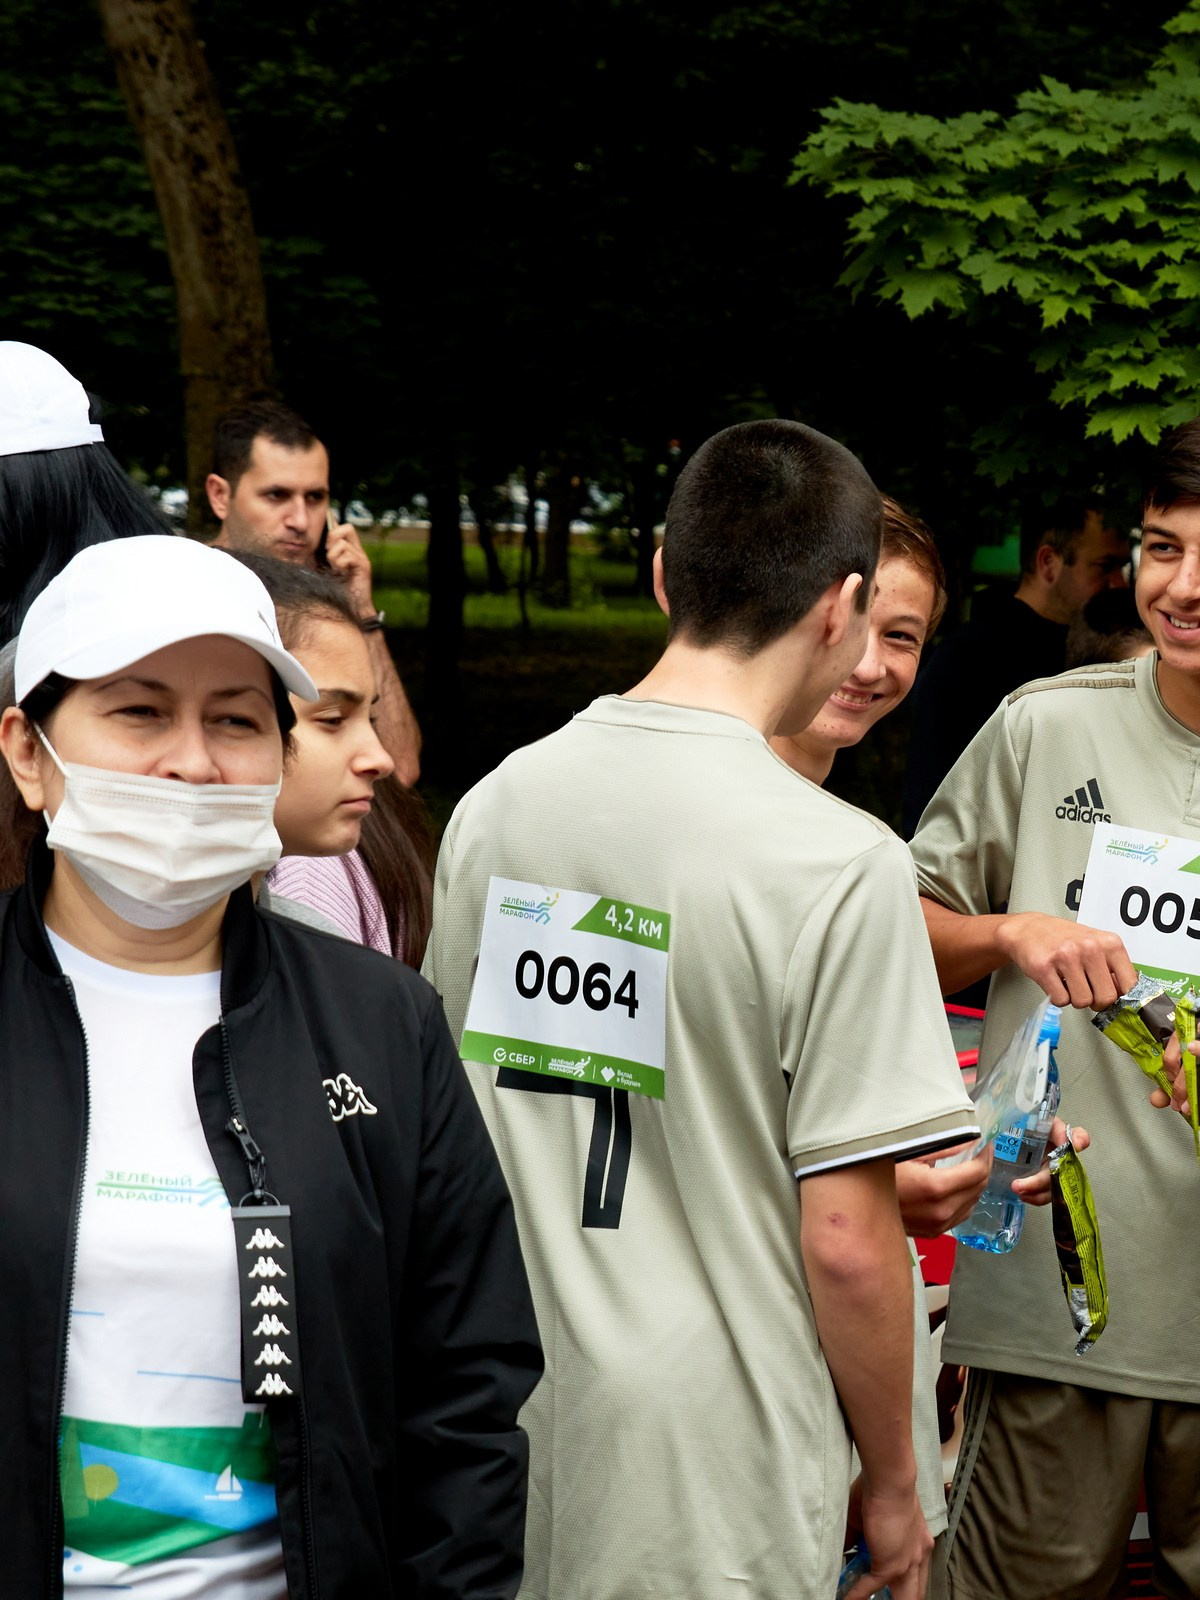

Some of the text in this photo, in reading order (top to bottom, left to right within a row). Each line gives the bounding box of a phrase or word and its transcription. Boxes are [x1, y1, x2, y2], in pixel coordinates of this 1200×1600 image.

[1055, 804, 1112, 824] adidas
[1110, 838, 1144, 851] ЗЕЛЁНЫЙ
[1105, 848, 1143, 861] МАРАФОН
[502, 896, 536, 908] ЗЕЛЁНЫЙ
[499, 908, 535, 920] МАРАФОН
[604, 904, 663, 940] 4,2 КМ
[515, 949, 639, 1019] 0064
[508, 1052, 536, 1067] СБЕР
[104, 1170, 193, 1187] ЗЕЛЁНЫЙ
[96, 1188, 192, 1204] МАРАФОН
